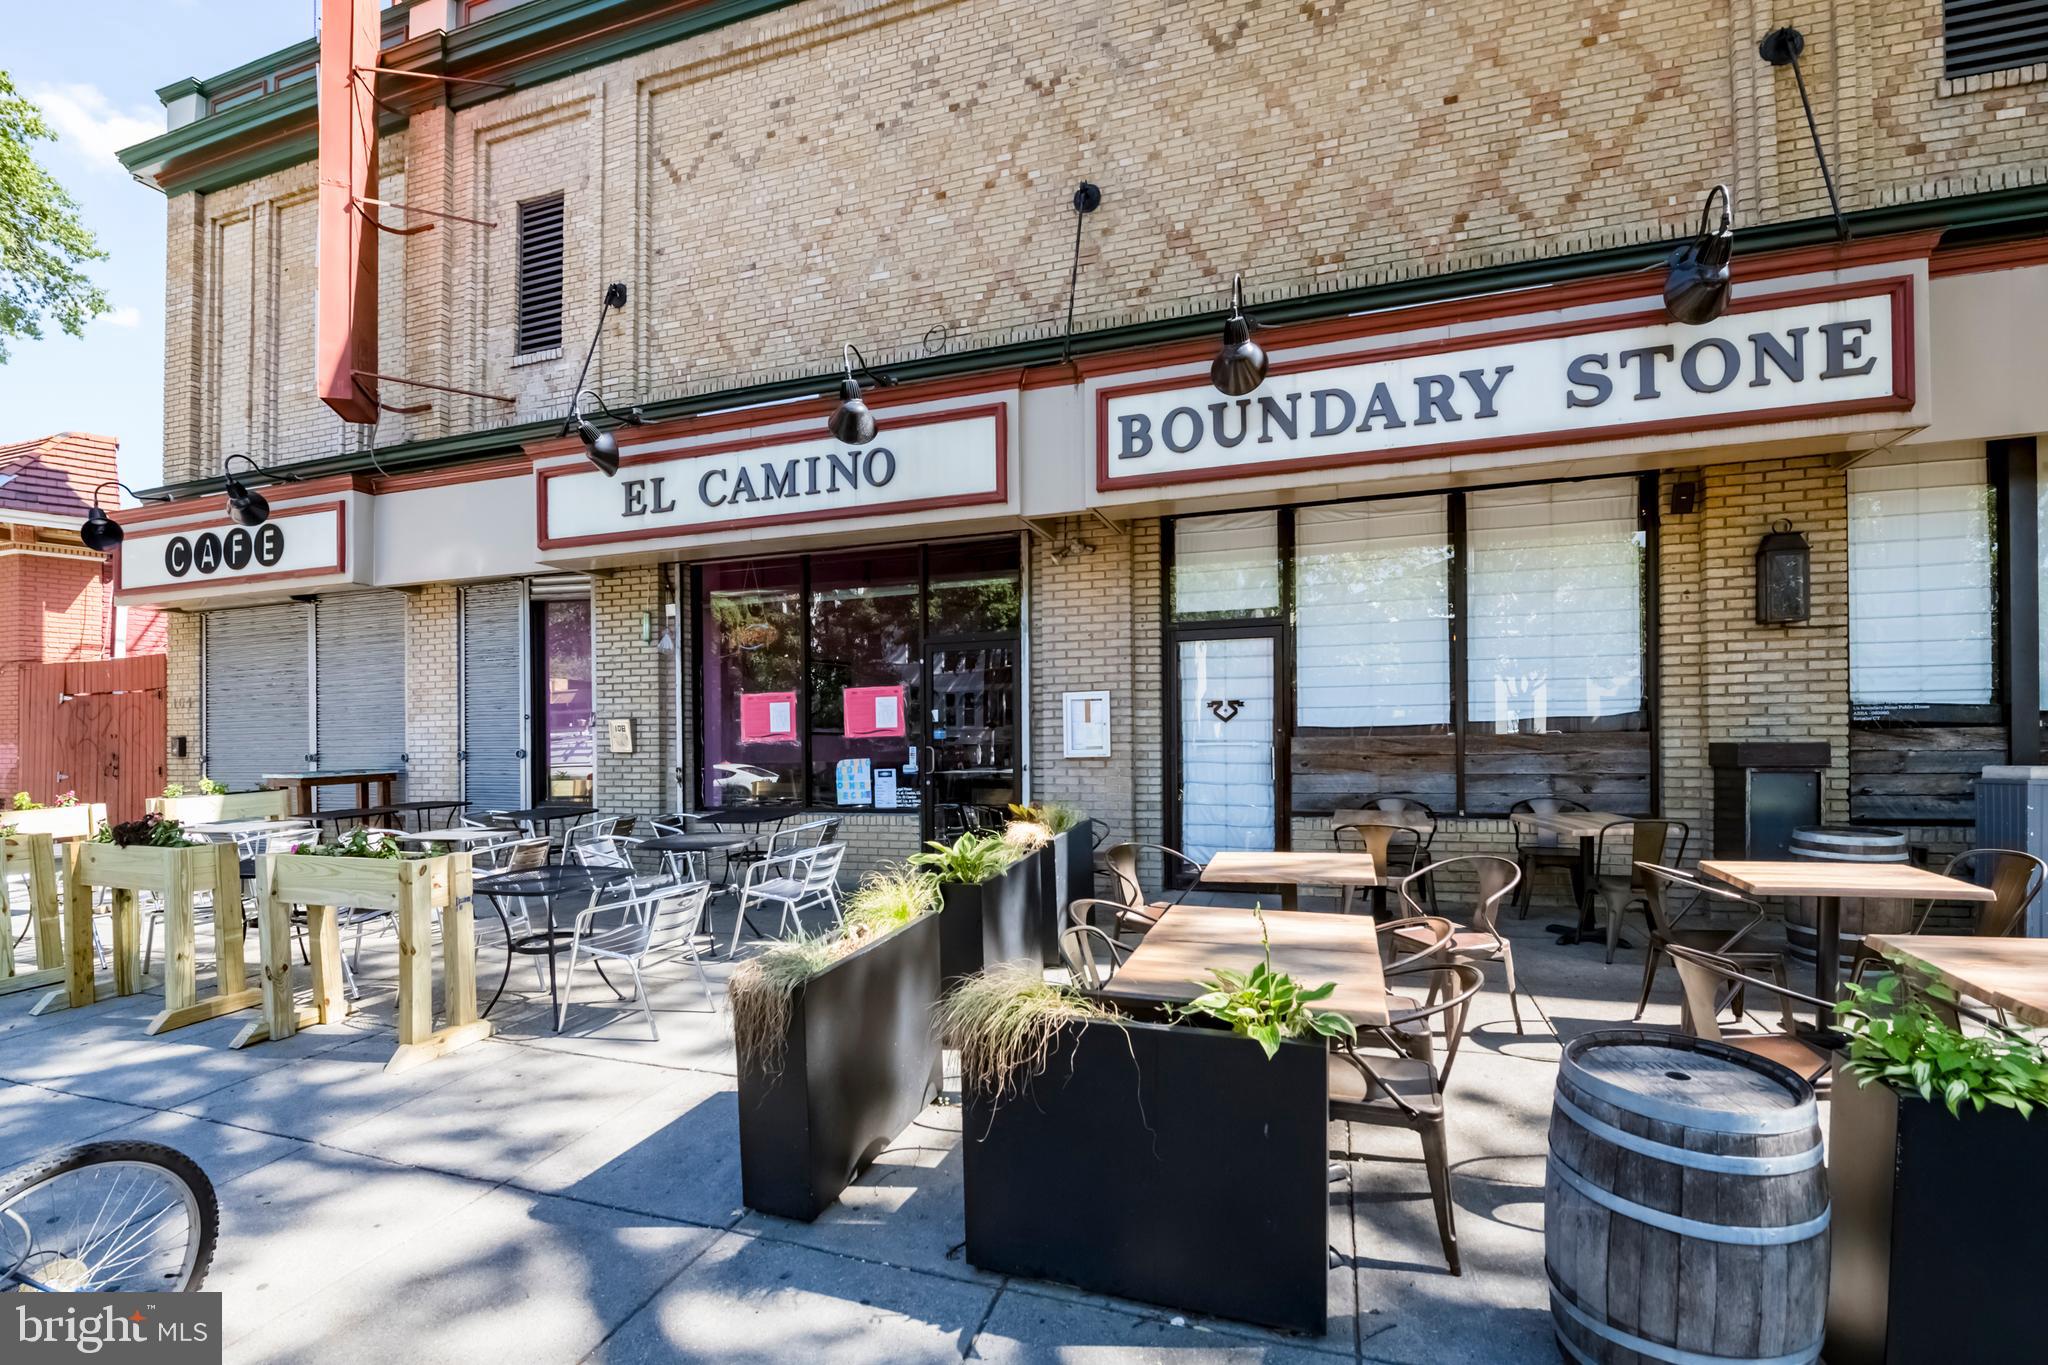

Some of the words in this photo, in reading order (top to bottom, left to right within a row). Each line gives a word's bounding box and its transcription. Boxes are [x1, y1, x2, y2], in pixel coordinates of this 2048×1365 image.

[1117, 364, 1515, 460] BOUNDARY
[1566, 318, 1878, 409] STONE
[620, 476, 676, 518] EL
[698, 446, 897, 508] CAMINO
[170, 528, 276, 573] CAFE
